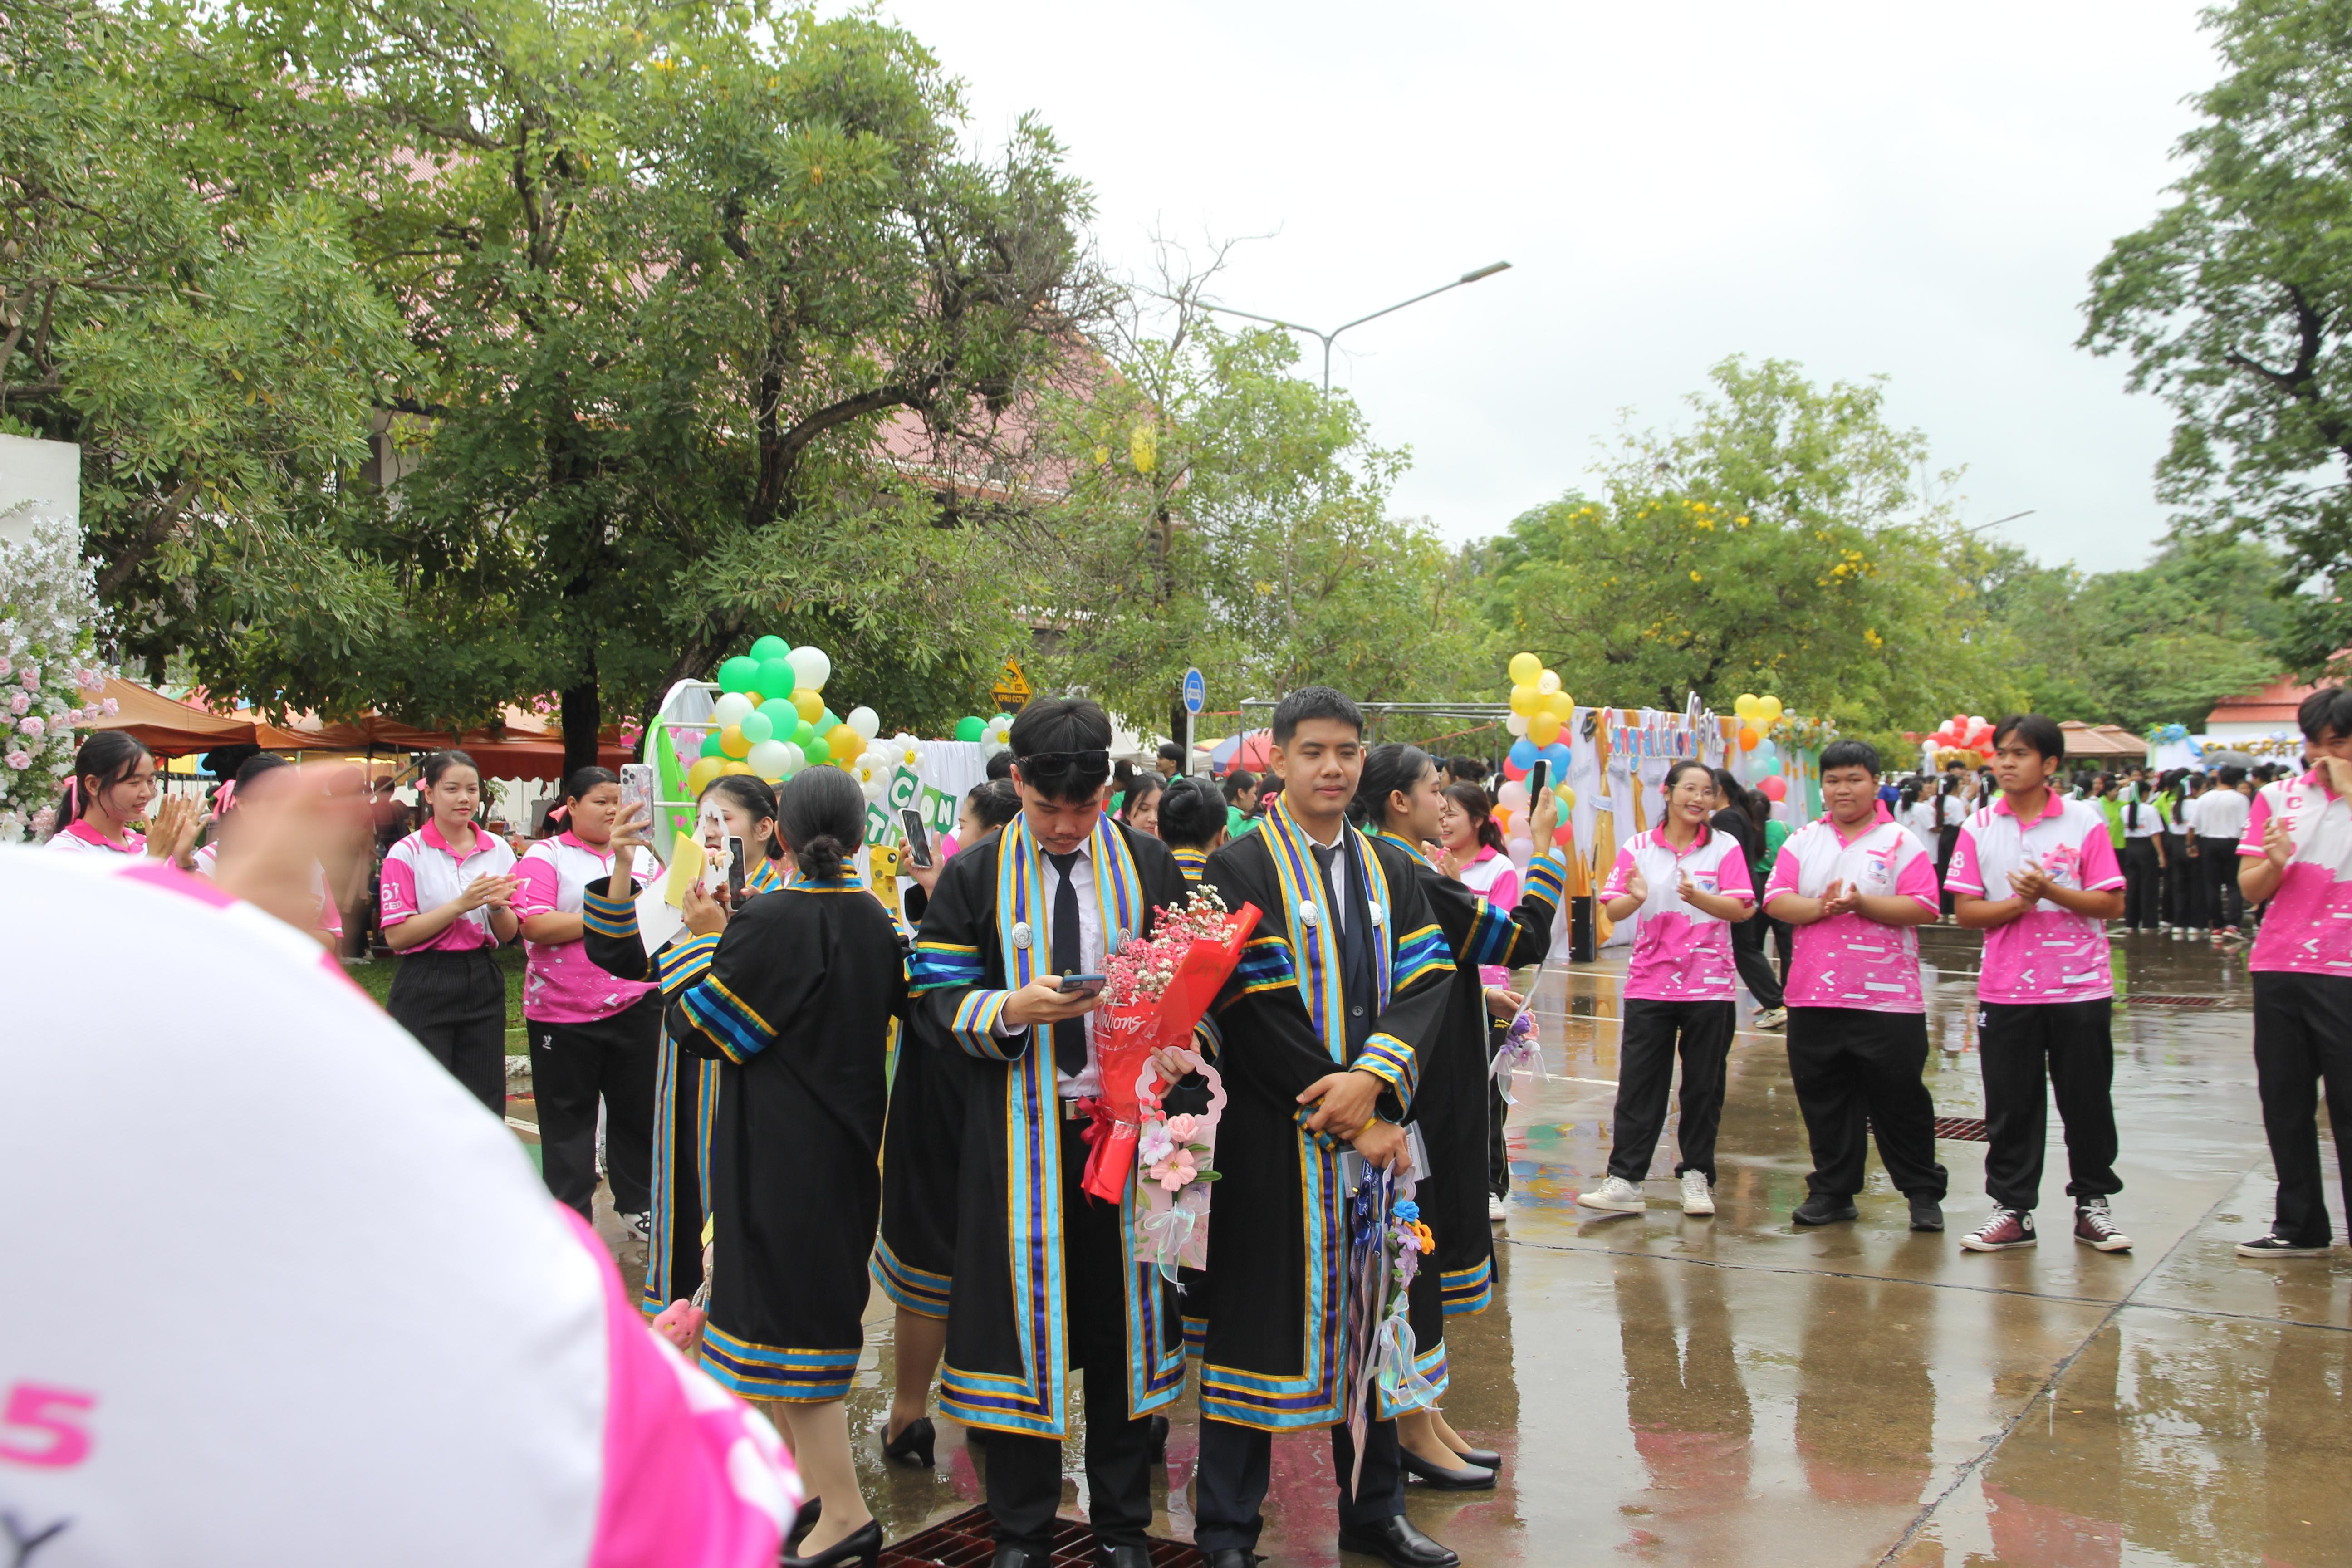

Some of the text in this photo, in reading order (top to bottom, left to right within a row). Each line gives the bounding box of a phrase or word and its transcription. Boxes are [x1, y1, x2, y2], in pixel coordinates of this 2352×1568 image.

[998, 694, 1025, 703] KPRU CCTV
[1602, 706, 1698, 772] Congratulations
[1946, 867, 1960, 877] ED
[383, 900, 402, 911] CED
